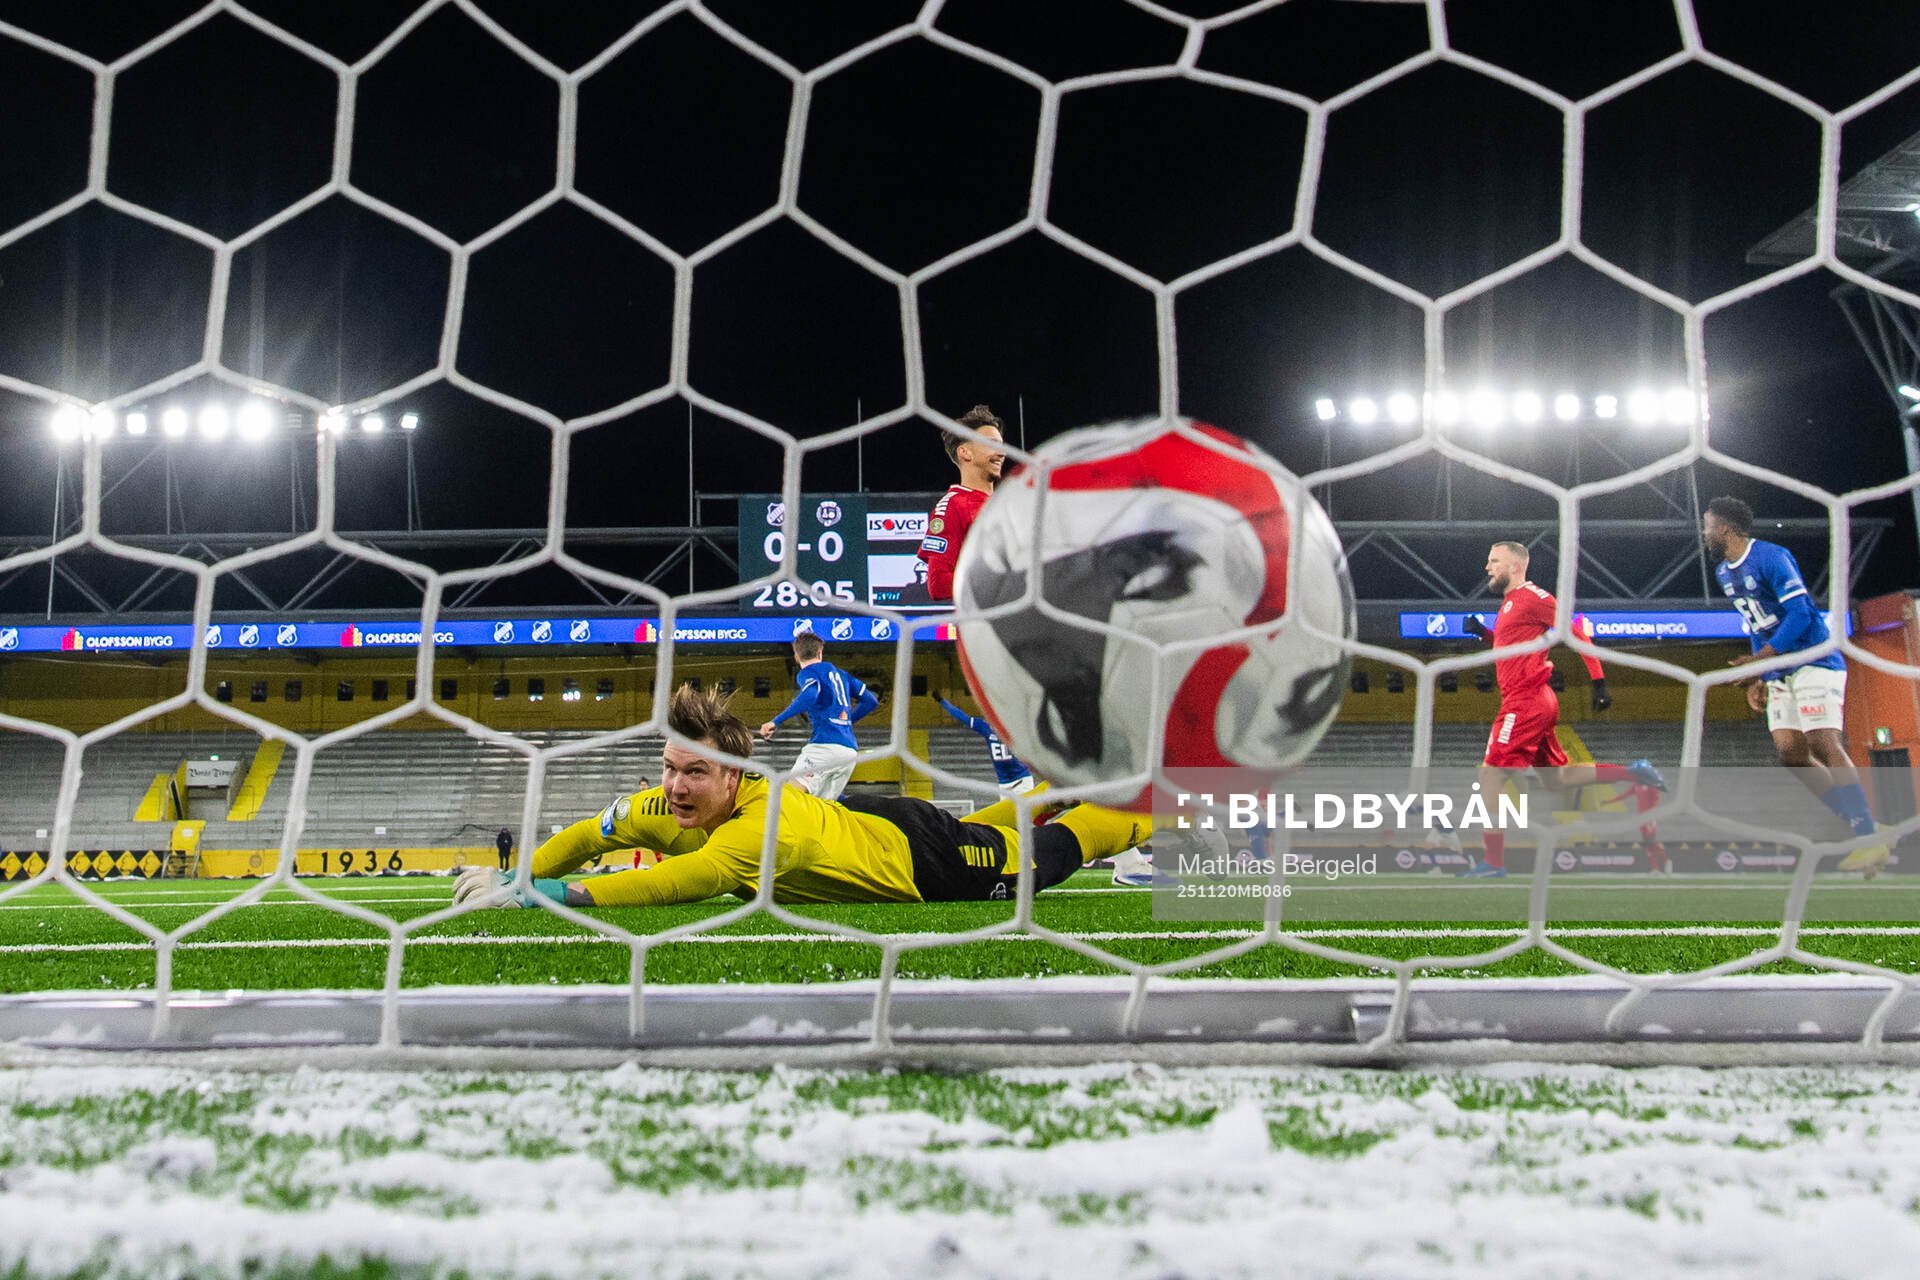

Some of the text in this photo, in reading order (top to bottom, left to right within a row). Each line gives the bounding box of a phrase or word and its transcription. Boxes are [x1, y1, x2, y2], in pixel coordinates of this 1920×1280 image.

[365, 633, 422, 644] OLOFSSON
[659, 629, 747, 640] OFSSON BYGG
[86, 636, 173, 647] OLOFSSON BYGG
[828, 671, 848, 707] 11
